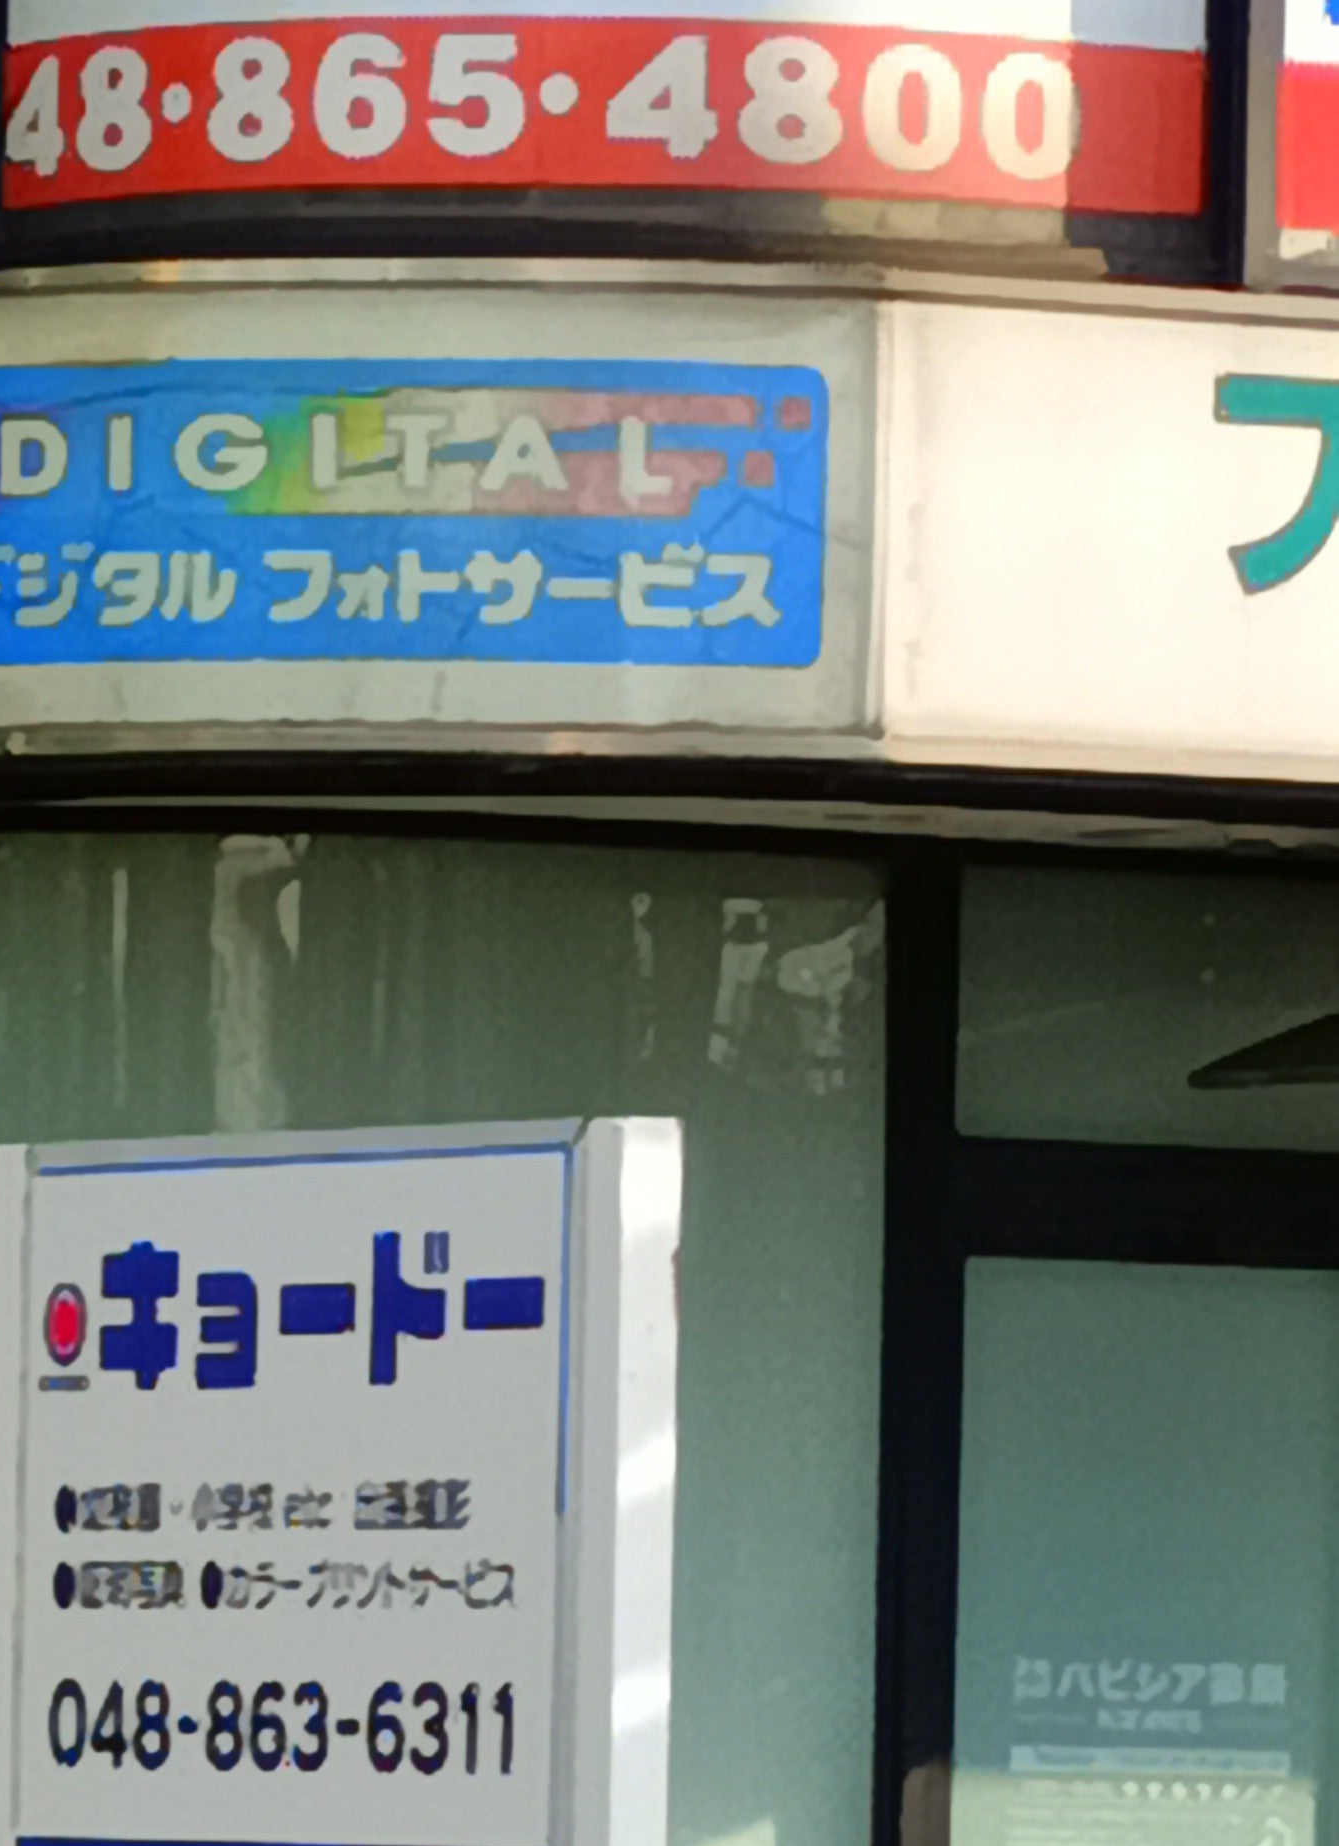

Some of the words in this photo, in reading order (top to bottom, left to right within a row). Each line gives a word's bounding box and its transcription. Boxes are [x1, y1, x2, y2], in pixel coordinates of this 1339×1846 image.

[99, 1231, 545, 1390] キョードー
[48, 1678, 514, 1776] 048-863-6311
